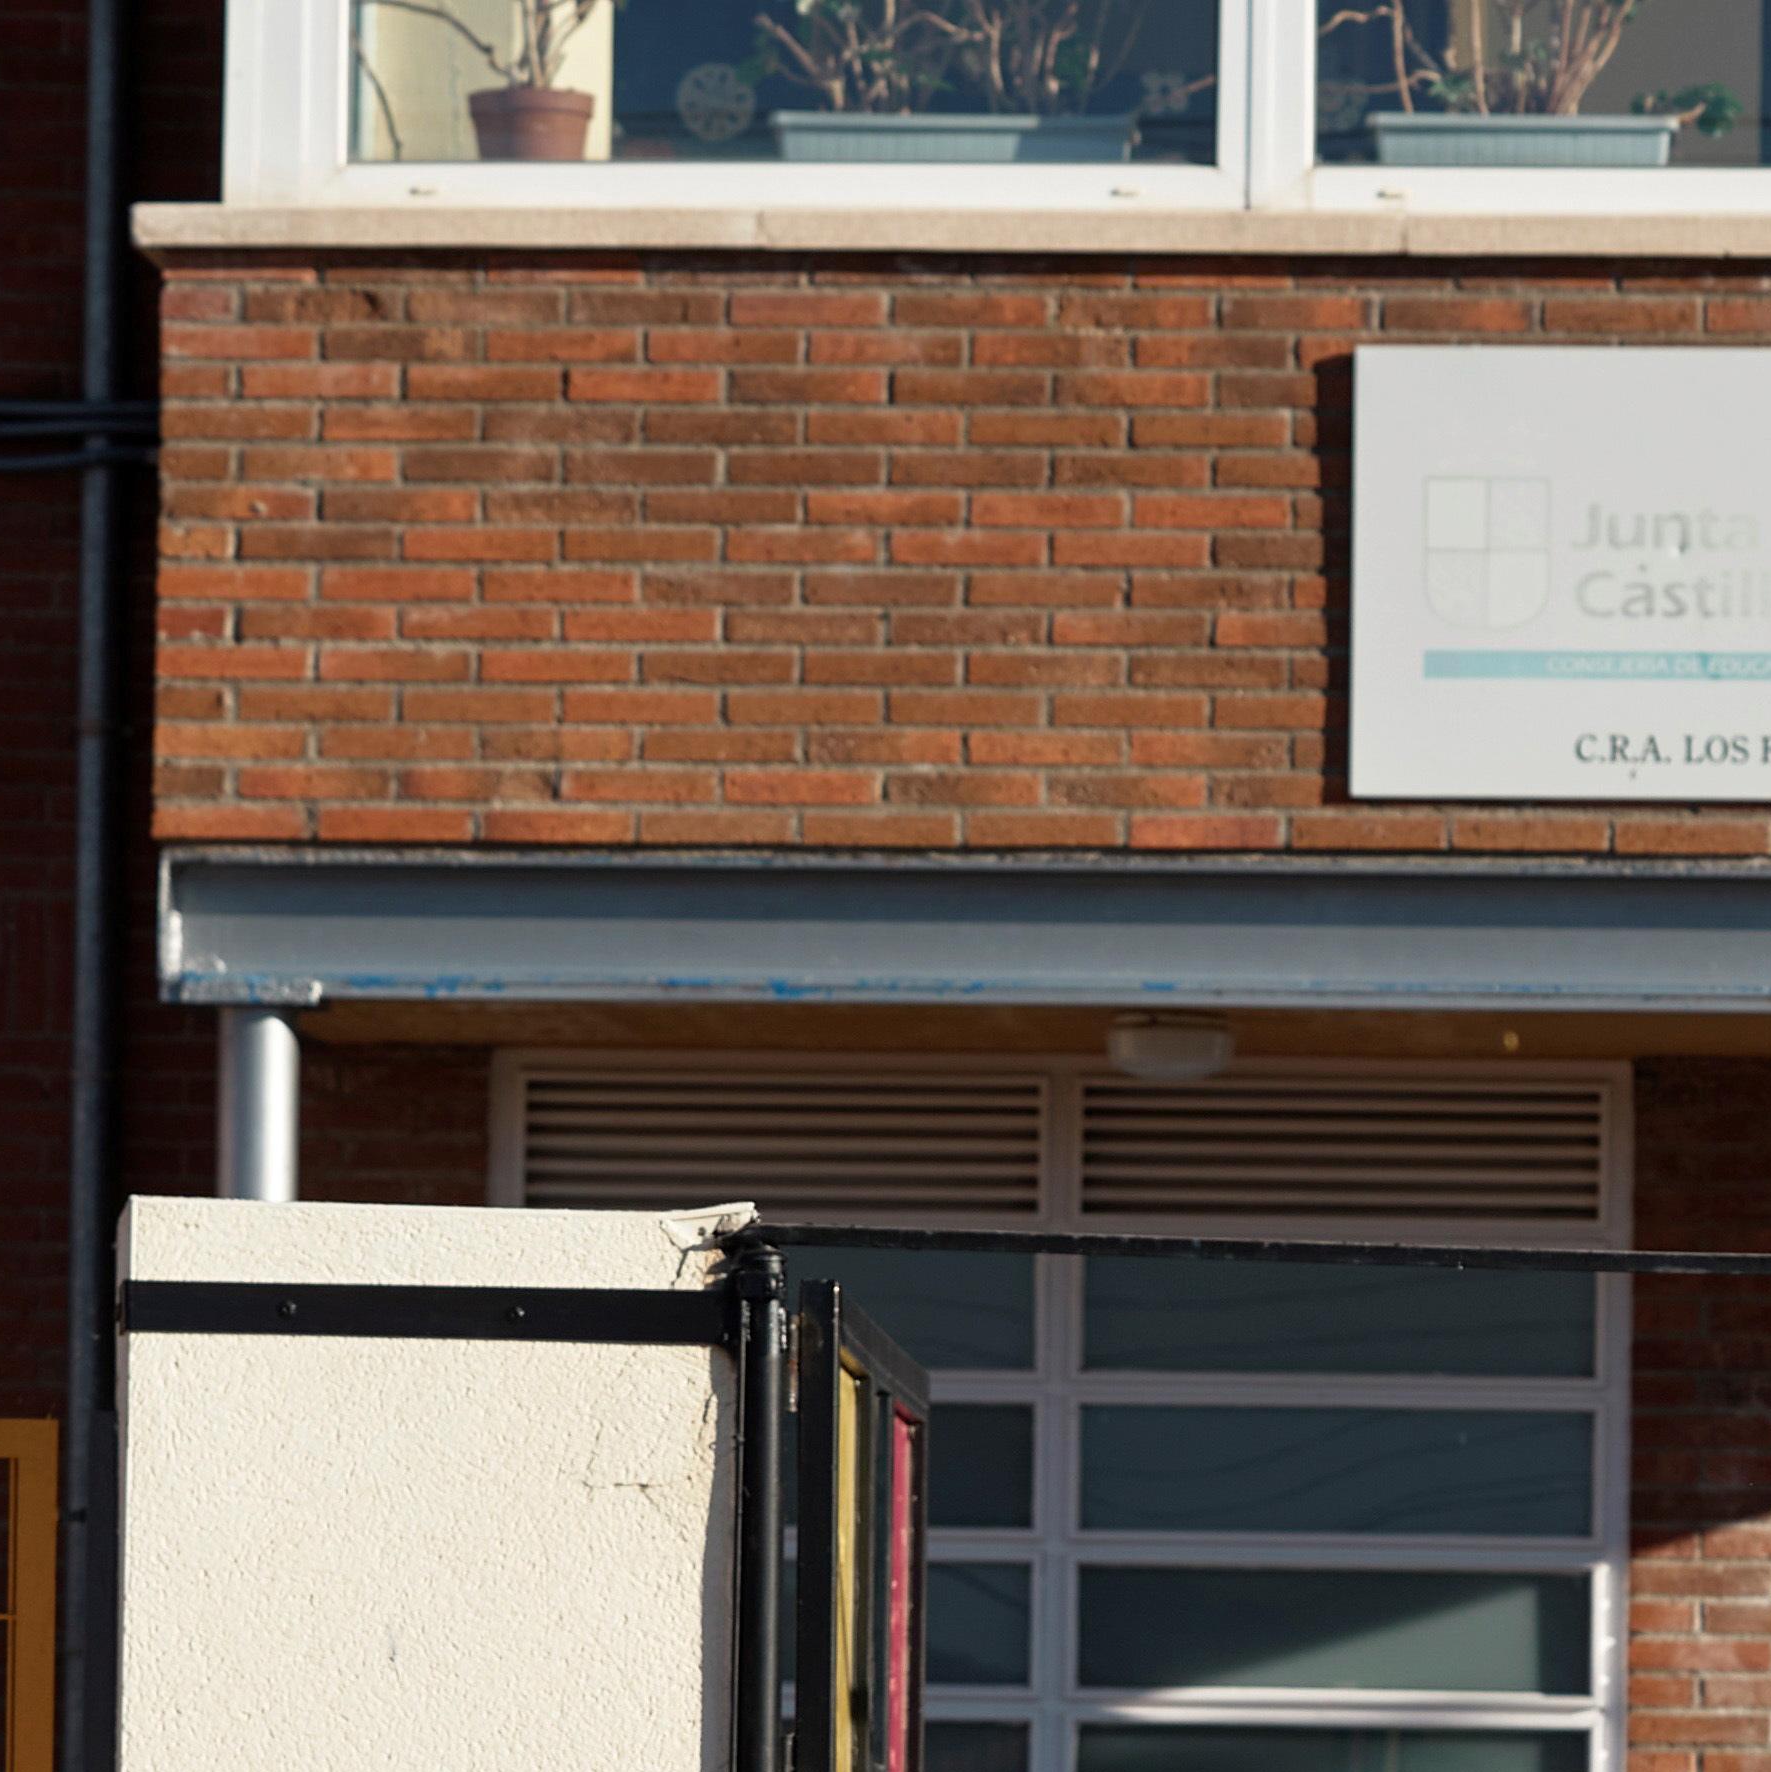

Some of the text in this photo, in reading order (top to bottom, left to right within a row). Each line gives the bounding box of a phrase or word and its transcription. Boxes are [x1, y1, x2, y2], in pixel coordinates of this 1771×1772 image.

[1571, 501, 1760, 554] Junta
[1574, 734, 1671, 764] C.R.A.
[1684, 735, 1750, 764] LOS
